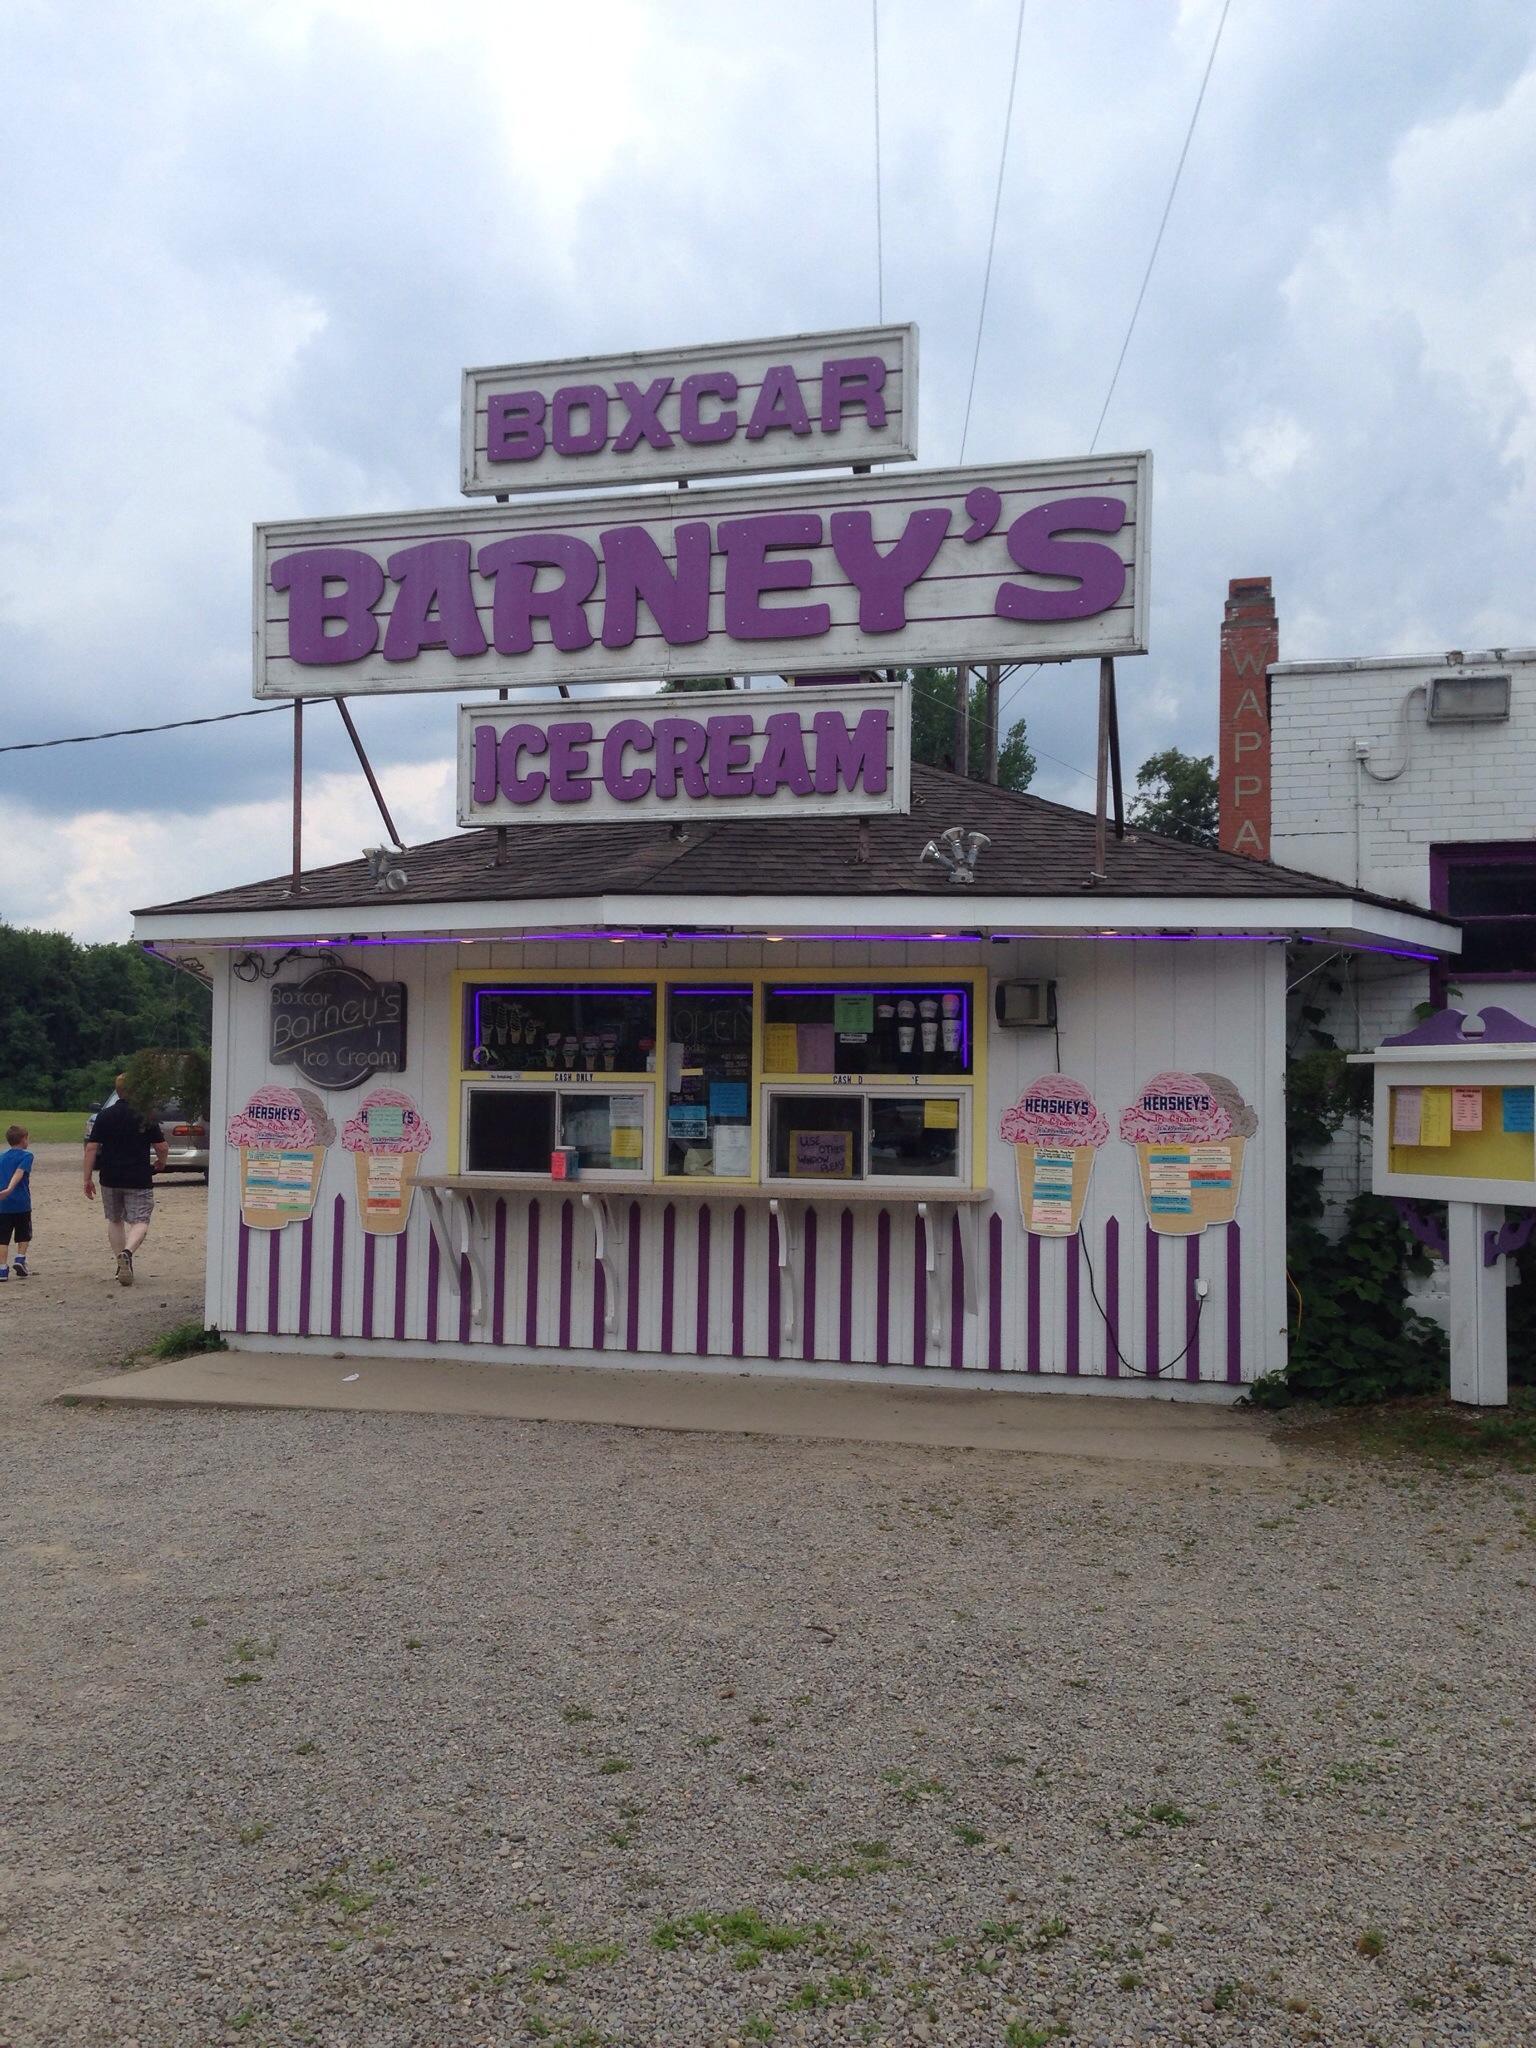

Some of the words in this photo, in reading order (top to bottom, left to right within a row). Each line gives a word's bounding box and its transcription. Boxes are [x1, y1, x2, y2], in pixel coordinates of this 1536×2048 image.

[487, 357, 888, 462] BOXCAR
[270, 487, 1128, 666] BARNEY'S
[474, 722, 593, 804] ICE
[602, 709, 890, 800] CREAM
[272, 987, 333, 1006] Boxcar
[303, 1047, 329, 1066] Ice
[336, 1047, 397, 1066] Cream
[555, 1073, 572, 1082] CASH
[576, 1073, 594, 1082] ONLY
[833, 1075, 852, 1085] CASH
